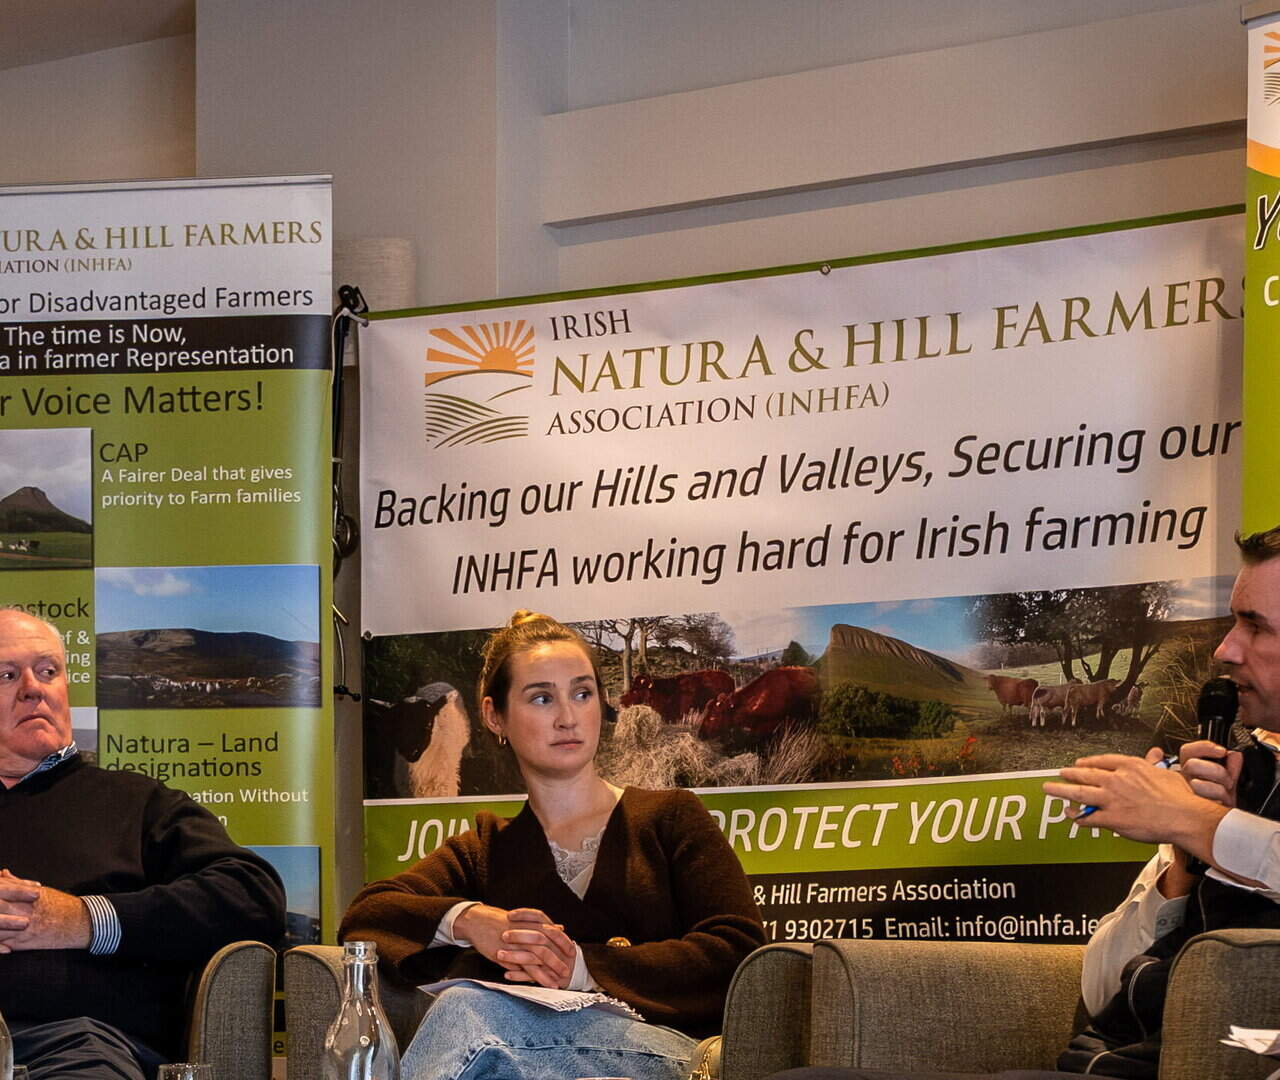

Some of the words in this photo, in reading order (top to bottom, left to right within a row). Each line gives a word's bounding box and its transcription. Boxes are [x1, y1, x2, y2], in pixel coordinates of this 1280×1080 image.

[75, 227, 97, 250] &
[104, 225, 174, 249] HILL
[184, 220, 322, 247] FARMERS
[63, 257, 132, 273] (INHFA)
[29, 286, 206, 315] Disadvantaged
[215, 287, 313, 309] Farmers
[4, 325, 45, 346] The
[51, 325, 101, 344] time
[108, 324, 125, 344] is
[132, 324, 187, 346] Now,
[549, 308, 632, 341] IRISH
[549, 334, 776, 396] NATURA
[788, 329, 830, 372] &
[842, 311, 973, 368] HILL
[991, 276, 1245, 351] FARMER
[18, 350, 37, 369] in
[45, 349, 120, 369] farmer
[127, 344, 294, 371] Representation
[22, 386, 111, 416] Voice
[124, 381, 263, 414] Matters!
[545, 394, 757, 436] ASSOCIATION
[765, 381, 890, 420] (INHFA)
[99, 442, 148, 463] CAP
[101, 469, 114, 483] A
[119, 468, 166, 483] Fairer
[171, 466, 207, 482] Deal
[212, 466, 246, 481] that
[250, 466, 293, 483] gives
[374, 482, 511, 529] Backing
[520, 475, 583, 516] our
[591, 464, 679, 509] Hills
[687, 455, 768, 501] and
[779, 446, 933, 495] Valleys,
[948, 423, 1146, 478] Securing
[1159, 420, 1242, 460] our
[101, 491, 163, 509] priority
[167, 492, 185, 505] to
[191, 490, 231, 505] Farm
[237, 488, 302, 503] families
[452, 547, 559, 595] INHFA
[572, 537, 727, 586] working
[736, 523, 832, 572] hard
[842, 521, 905, 565] for
[915, 510, 1009, 560] Irish
[1024, 500, 1208, 552] farming
[77, 630, 91, 645] &
[106, 733, 190, 753] Natura
[222, 731, 279, 753] Land
[239, 788, 309, 803] Without
[908, 794, 1027, 844] YOUR
[753, 885, 766, 905] &
[771, 883, 801, 905] Hill
[806, 882, 888, 904] Farmers
[892, 877, 1016, 901] Association
[785, 918, 873, 940] 9302715
[885, 916, 950, 939] Email:
[955, 913, 1099, 941] info@inhfa.ie
